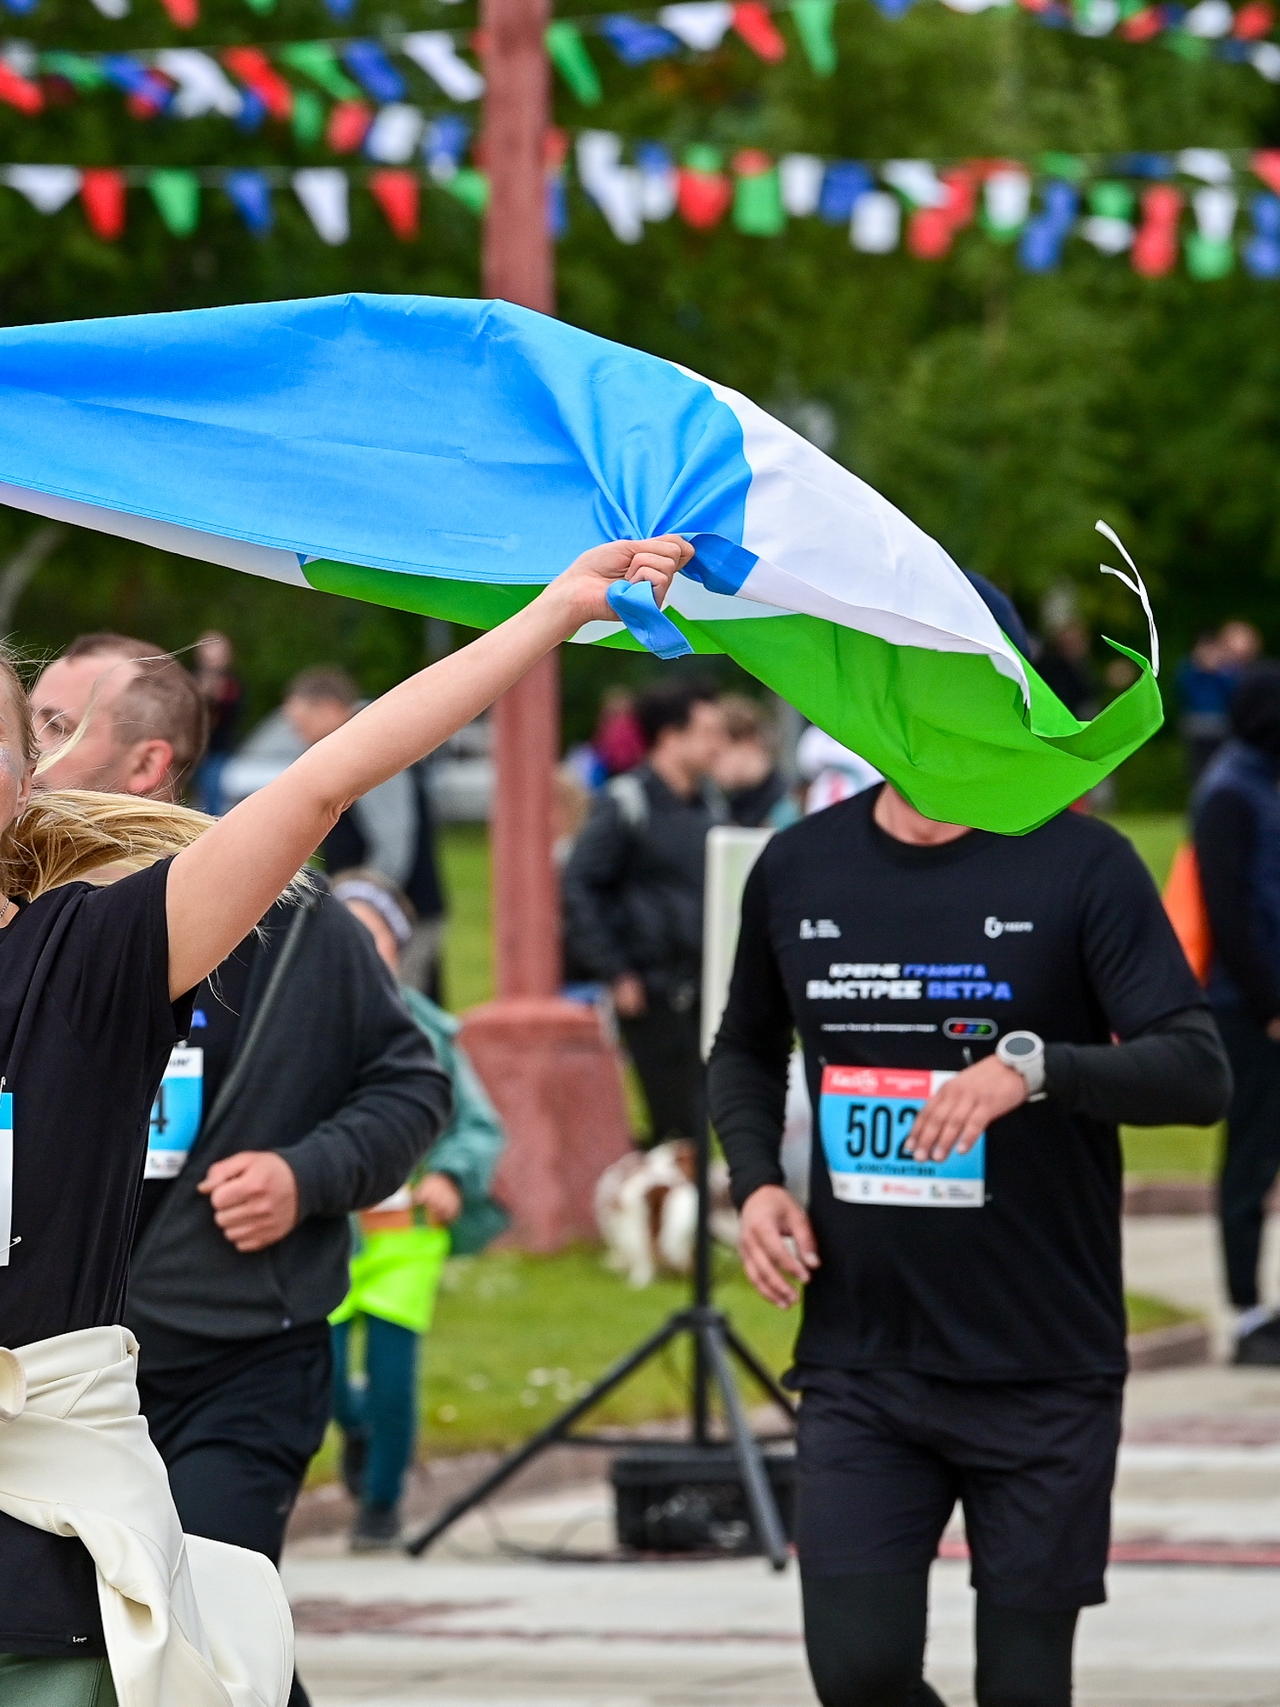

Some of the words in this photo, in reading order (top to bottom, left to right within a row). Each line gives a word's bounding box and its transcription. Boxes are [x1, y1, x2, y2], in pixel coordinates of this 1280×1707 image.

[903, 964, 987, 978] ГРАНИТА
[806, 980, 922, 999] БЫСТРЕЕ
[927, 981, 1013, 1000] ВЕТРА
